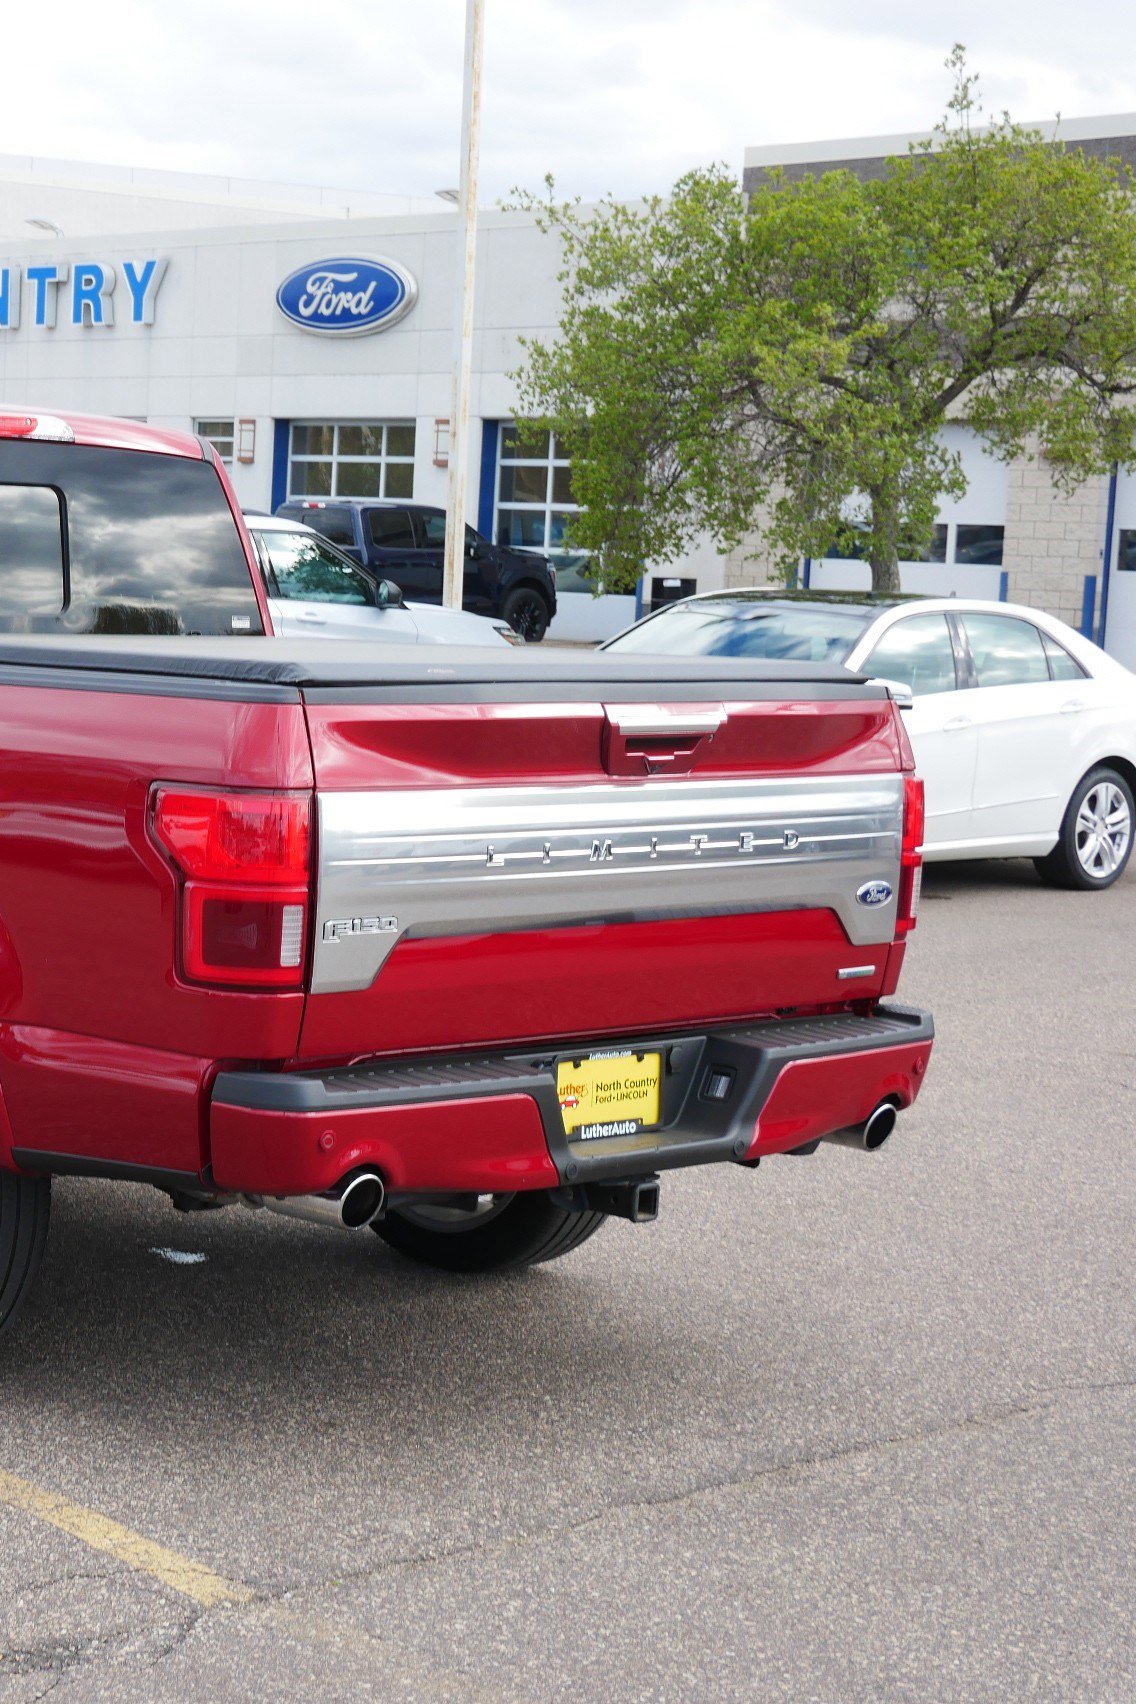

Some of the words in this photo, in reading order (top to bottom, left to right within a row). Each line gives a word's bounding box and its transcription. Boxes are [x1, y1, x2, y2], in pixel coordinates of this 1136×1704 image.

[298, 271, 378, 317] Ford
[485, 829, 800, 867] LIMITED
[558, 1083, 586, 1097] uther
[595, 1080, 622, 1093] North
[624, 1077, 658, 1091] Country
[580, 1120, 637, 1140] LutherAuto
